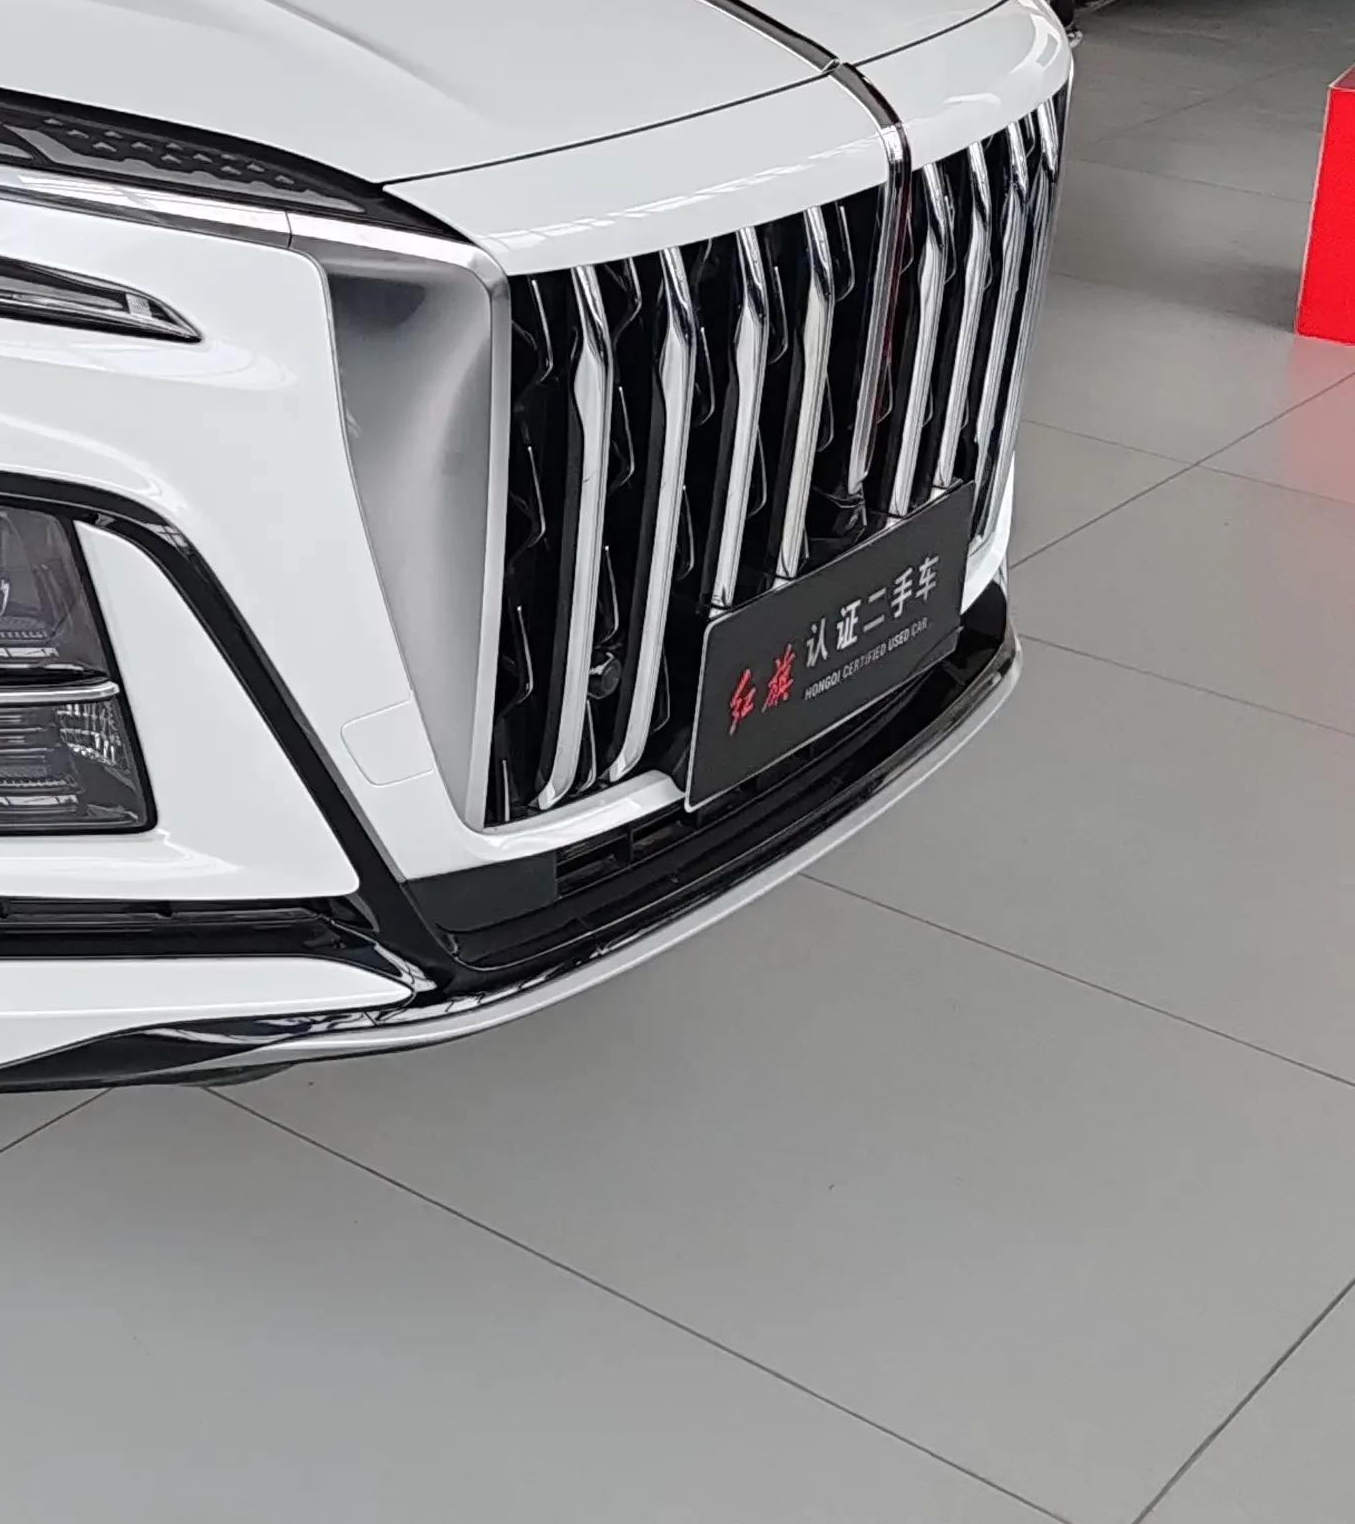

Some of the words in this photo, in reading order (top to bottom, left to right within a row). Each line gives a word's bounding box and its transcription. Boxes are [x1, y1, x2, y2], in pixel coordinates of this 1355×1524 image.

[729, 644, 796, 736] 红旗
[805, 555, 940, 668] 认证二手车
[804, 669, 841, 701] HONGQI
[842, 642, 887, 679] CERTIFIED
[887, 628, 910, 652] USED
[911, 617, 928, 637] CAR
